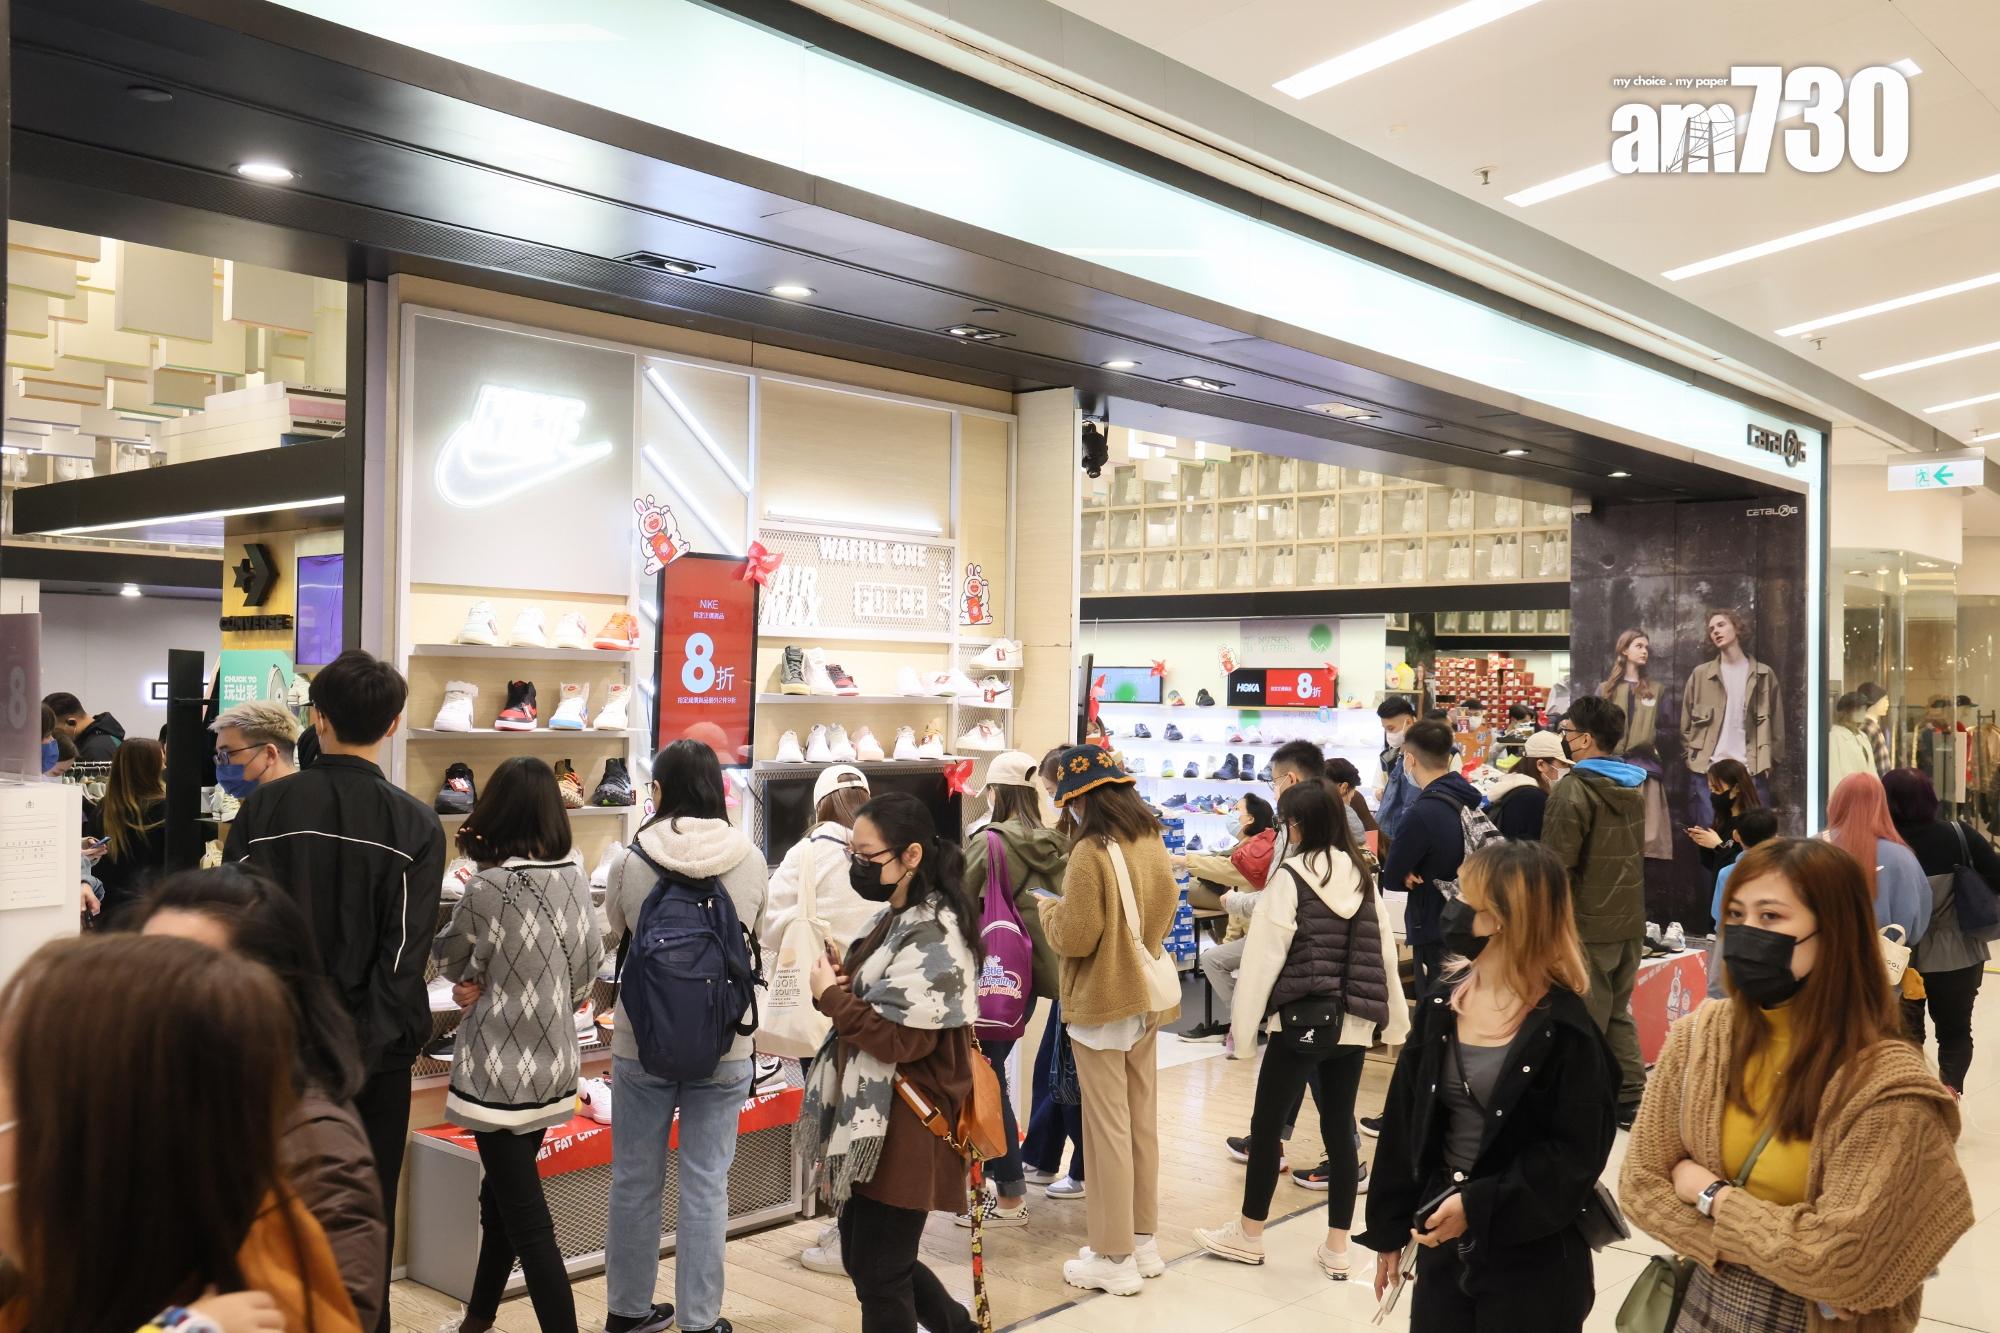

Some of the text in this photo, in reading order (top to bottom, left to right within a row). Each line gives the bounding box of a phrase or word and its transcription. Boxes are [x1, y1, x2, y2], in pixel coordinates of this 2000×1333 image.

[819, 537, 928, 568] WAFFLE ONE
[773, 565, 818, 598] AIR
[700, 599, 719, 610] NIKE
[759, 593, 820, 627] MAX
[681, 632, 735, 693] 8折
[224, 675, 246, 684] CHUCK
[1236, 683, 1260, 693] HOKA
[1296, 672, 1322, 699] 8折
[223, 683, 258, 701] 玩出彩
[554, 1135, 574, 1153] FAT
